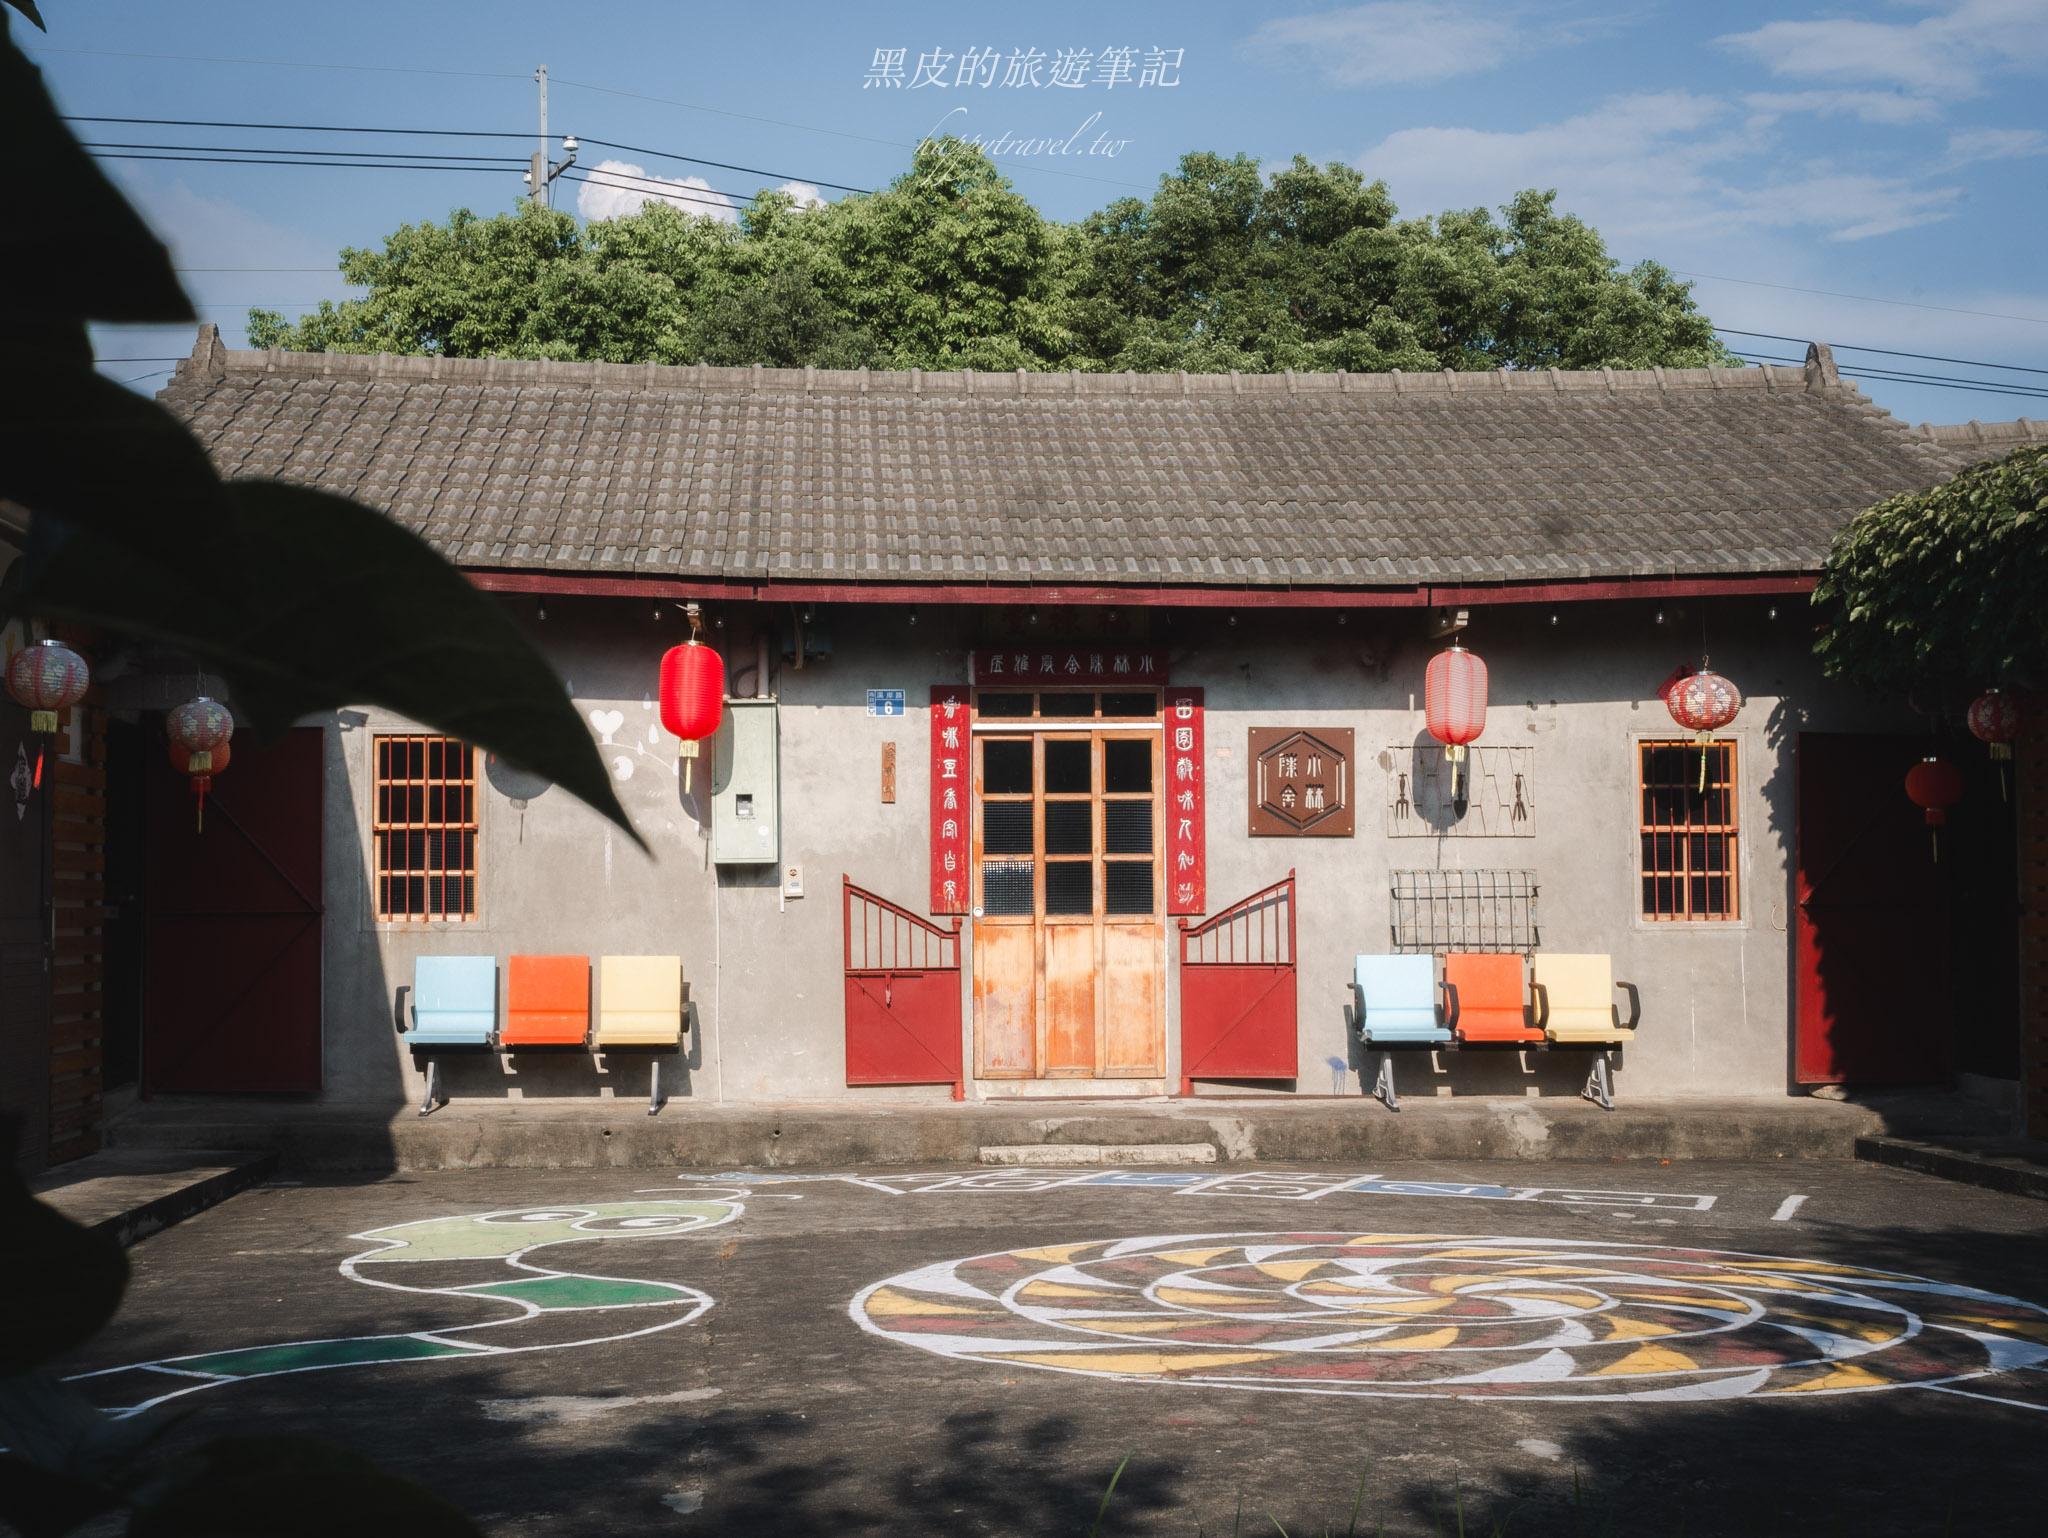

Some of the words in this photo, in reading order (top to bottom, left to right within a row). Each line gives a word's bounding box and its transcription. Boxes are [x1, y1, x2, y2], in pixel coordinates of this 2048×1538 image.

[884, 701, 893, 715] 6
[1113, 1174, 1203, 1182] 5
[1255, 1173, 1342, 1181] 4
[960, 1179, 1048, 1188] 6
[1216, 1184, 1309, 1194] 3
[1382, 1184, 1478, 1194] 2
[1562, 1195, 1655, 1204] 1
